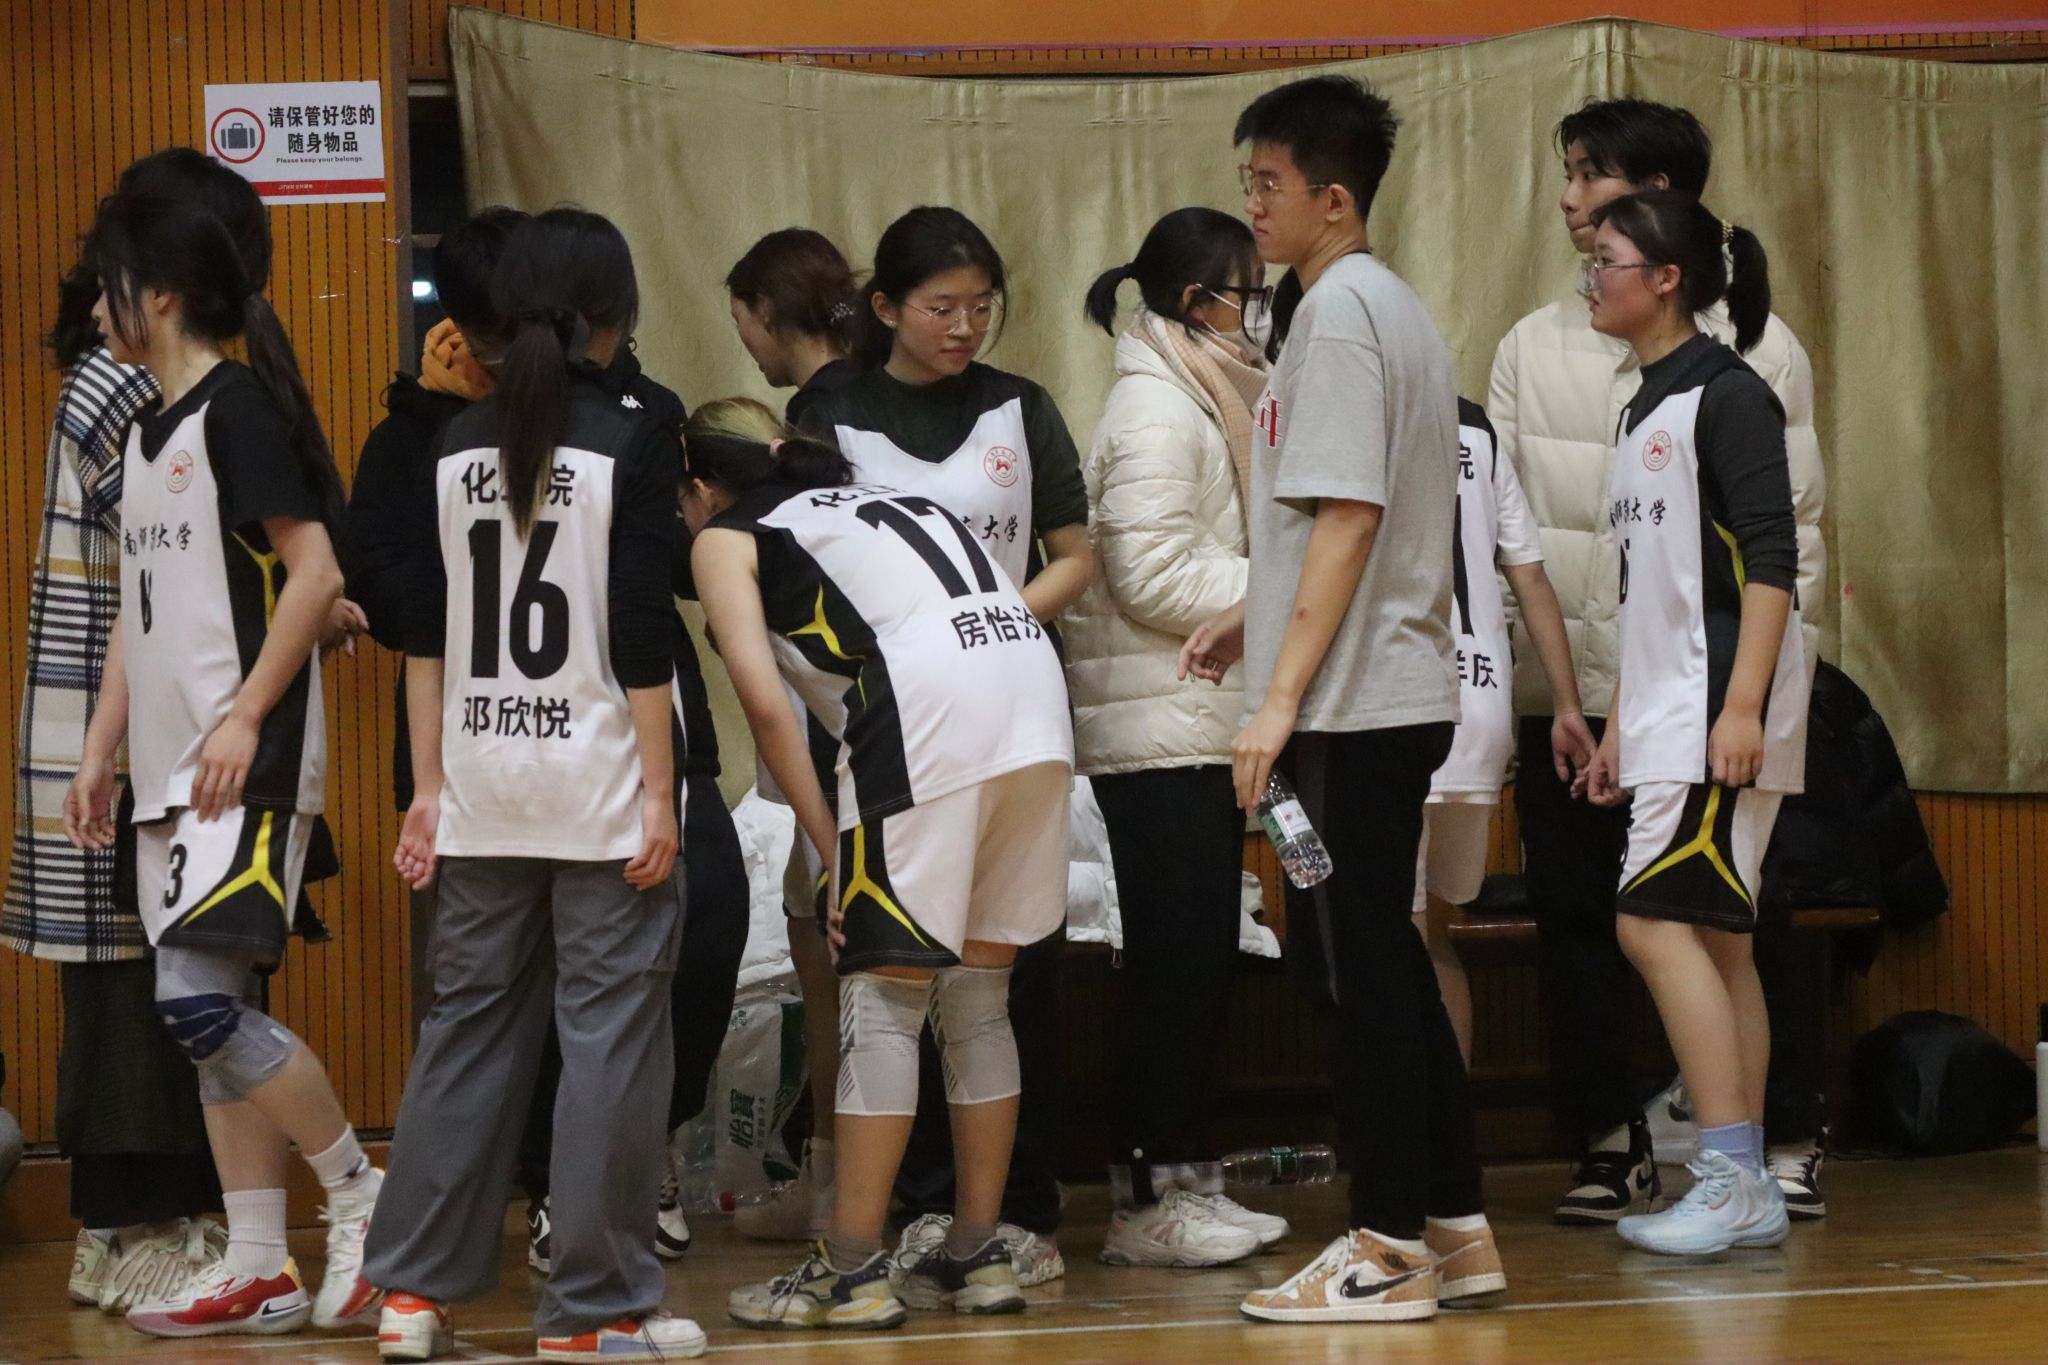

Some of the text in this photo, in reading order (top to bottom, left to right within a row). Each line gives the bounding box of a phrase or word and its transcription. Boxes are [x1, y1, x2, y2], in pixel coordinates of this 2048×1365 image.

[268, 104, 375, 128] 请保管好您的
[287, 132, 358, 154] 随身物品
[461, 462, 576, 507] 化院
[467, 518, 570, 681] 16
[461, 695, 572, 740] 邓欣悦
